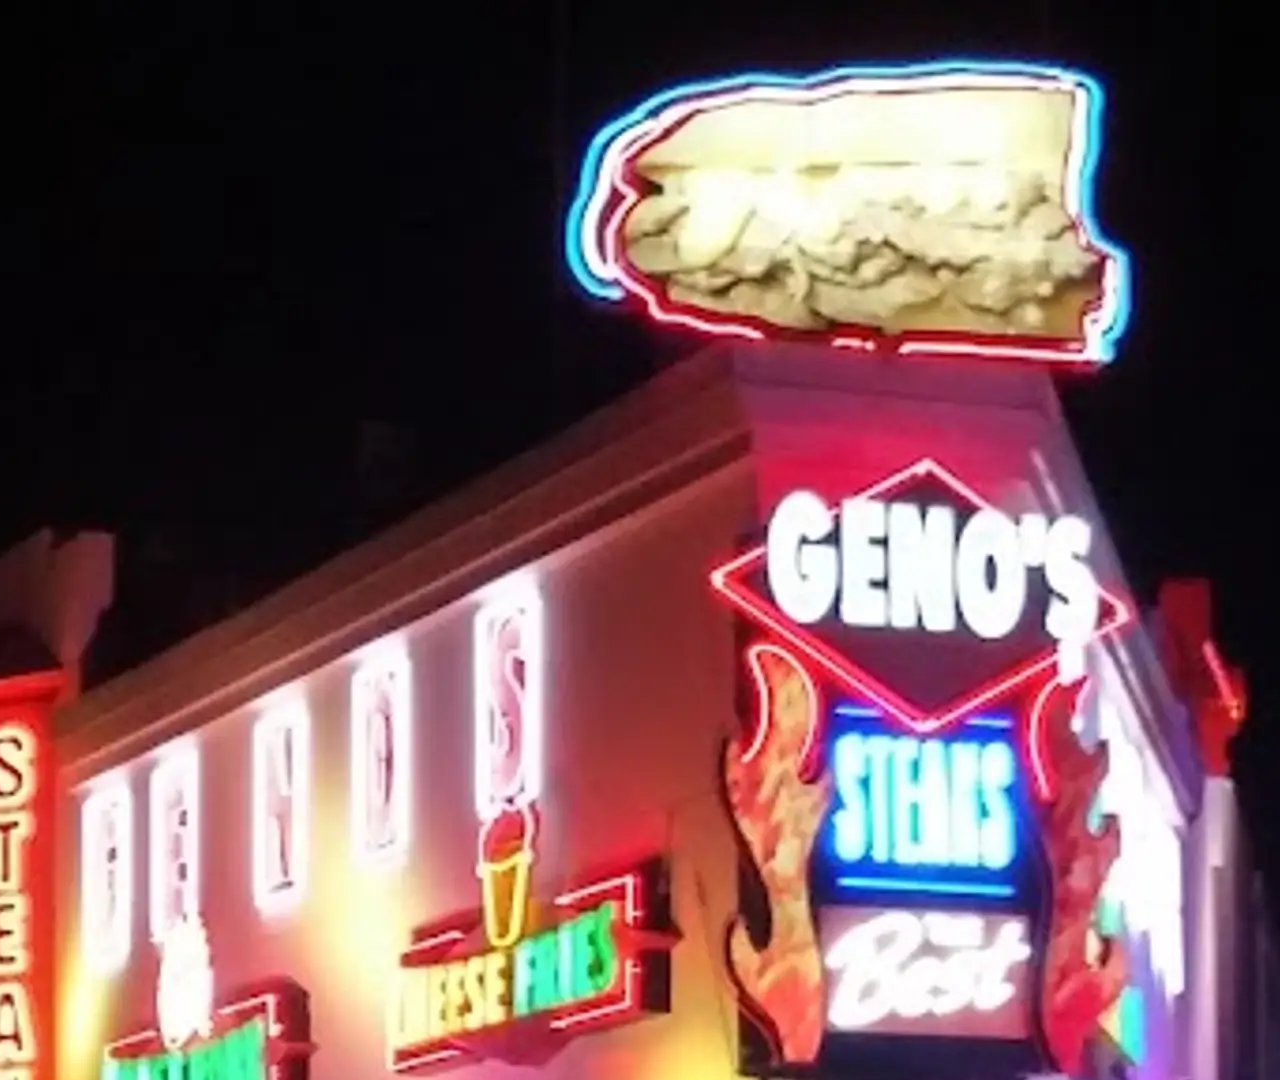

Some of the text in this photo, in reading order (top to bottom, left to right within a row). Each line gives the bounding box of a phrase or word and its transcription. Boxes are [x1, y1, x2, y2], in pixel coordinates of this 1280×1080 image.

[767, 489, 1099, 637] GENO'S
[832, 733, 1018, 870] STEAKS
[514, 902, 618, 1017] FRIES
